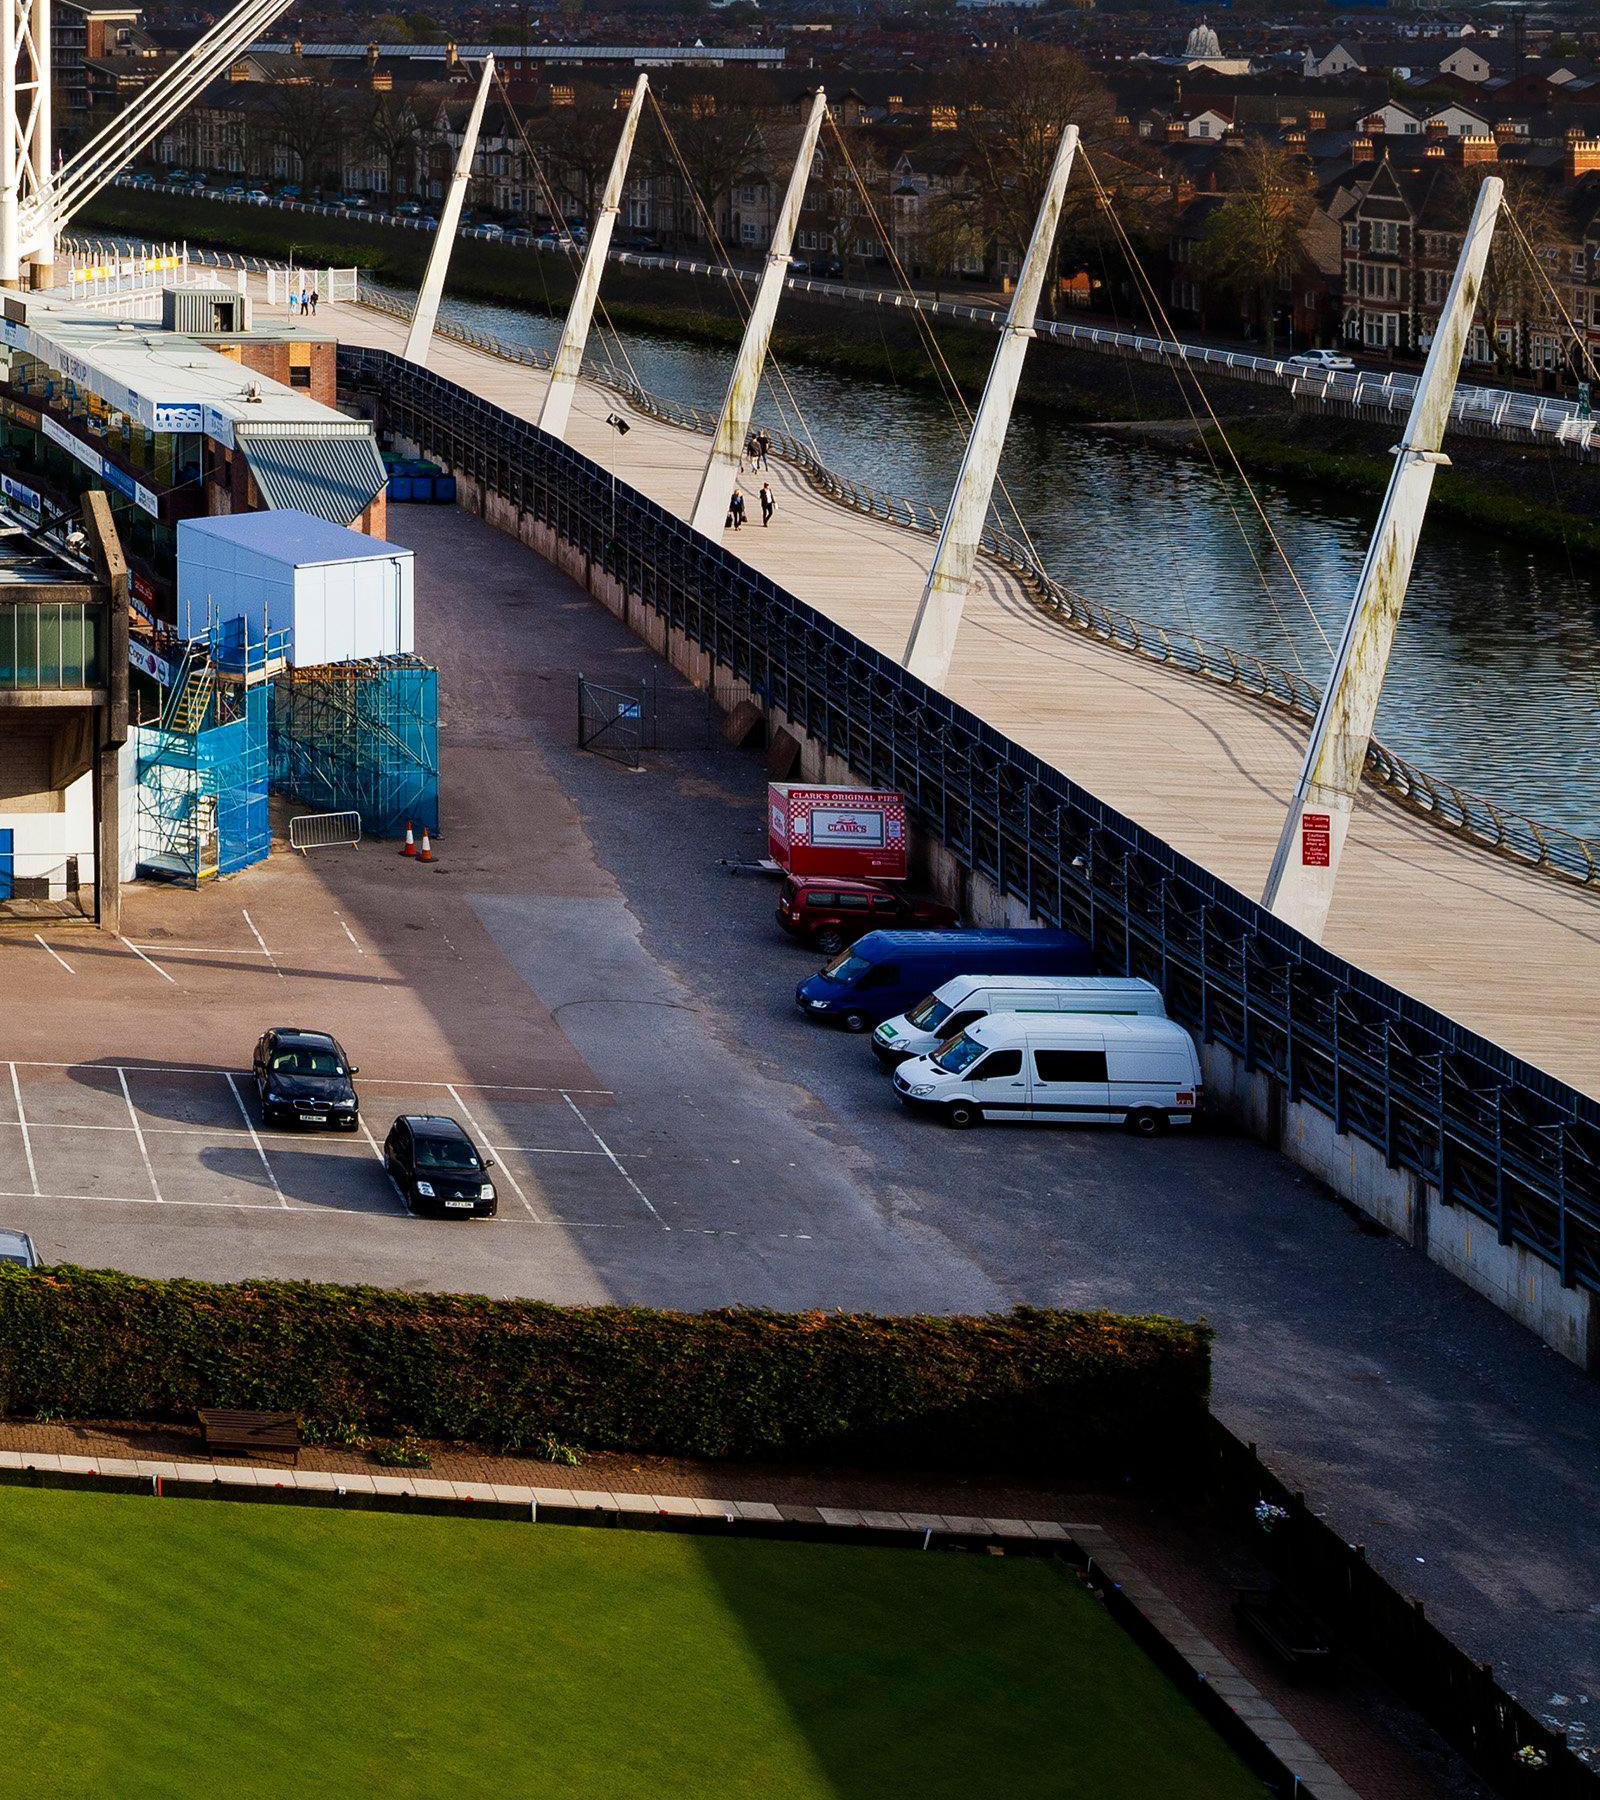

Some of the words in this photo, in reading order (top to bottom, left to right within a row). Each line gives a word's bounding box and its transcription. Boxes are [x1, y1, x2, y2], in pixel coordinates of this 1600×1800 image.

[792, 792, 830, 800] CLARK'S
[832, 793, 875, 802] ORIGINAL
[878, 794, 898, 802] PIES
[828, 823, 867, 833] CLARK'S
